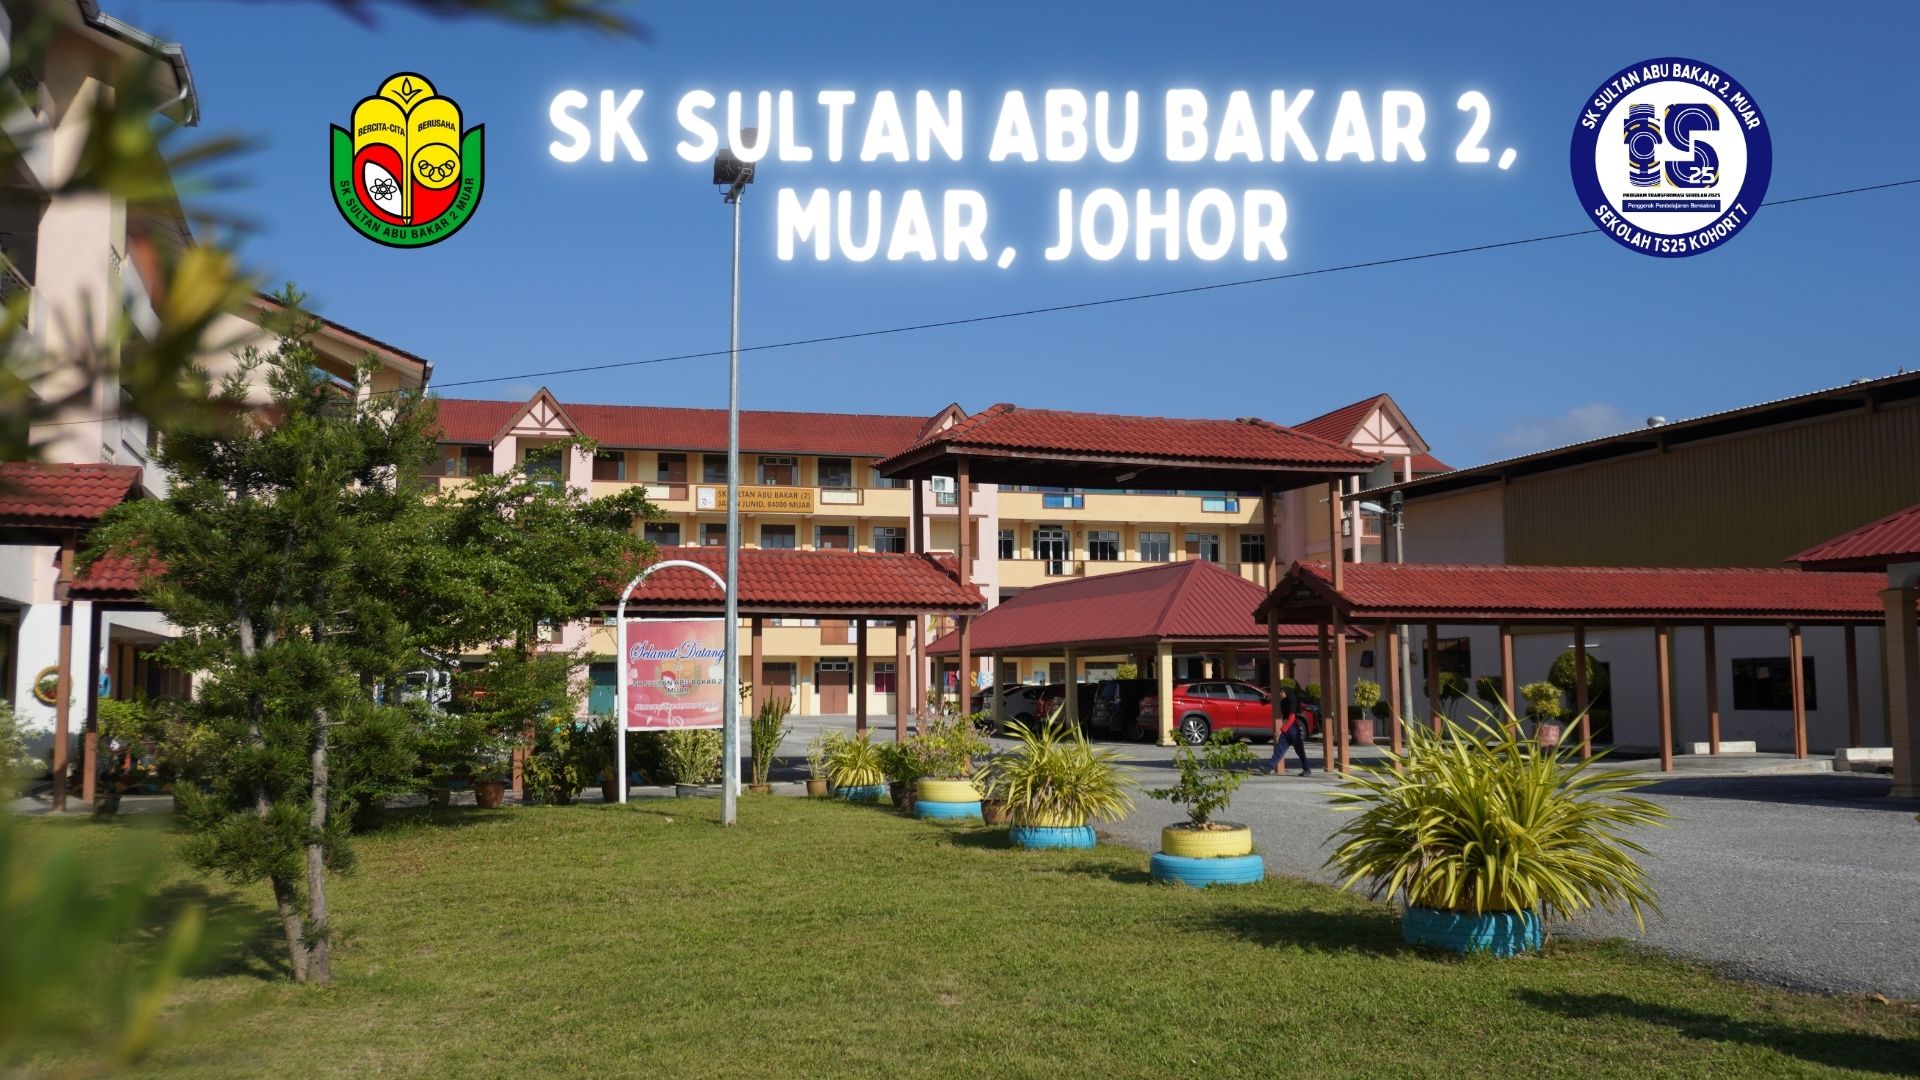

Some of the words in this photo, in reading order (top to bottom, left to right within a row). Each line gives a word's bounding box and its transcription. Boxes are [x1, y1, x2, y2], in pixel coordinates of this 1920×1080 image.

[757, 491, 772, 499] ABU
[630, 640, 678, 664] Selamat
[680, 640, 725, 665] Datang
